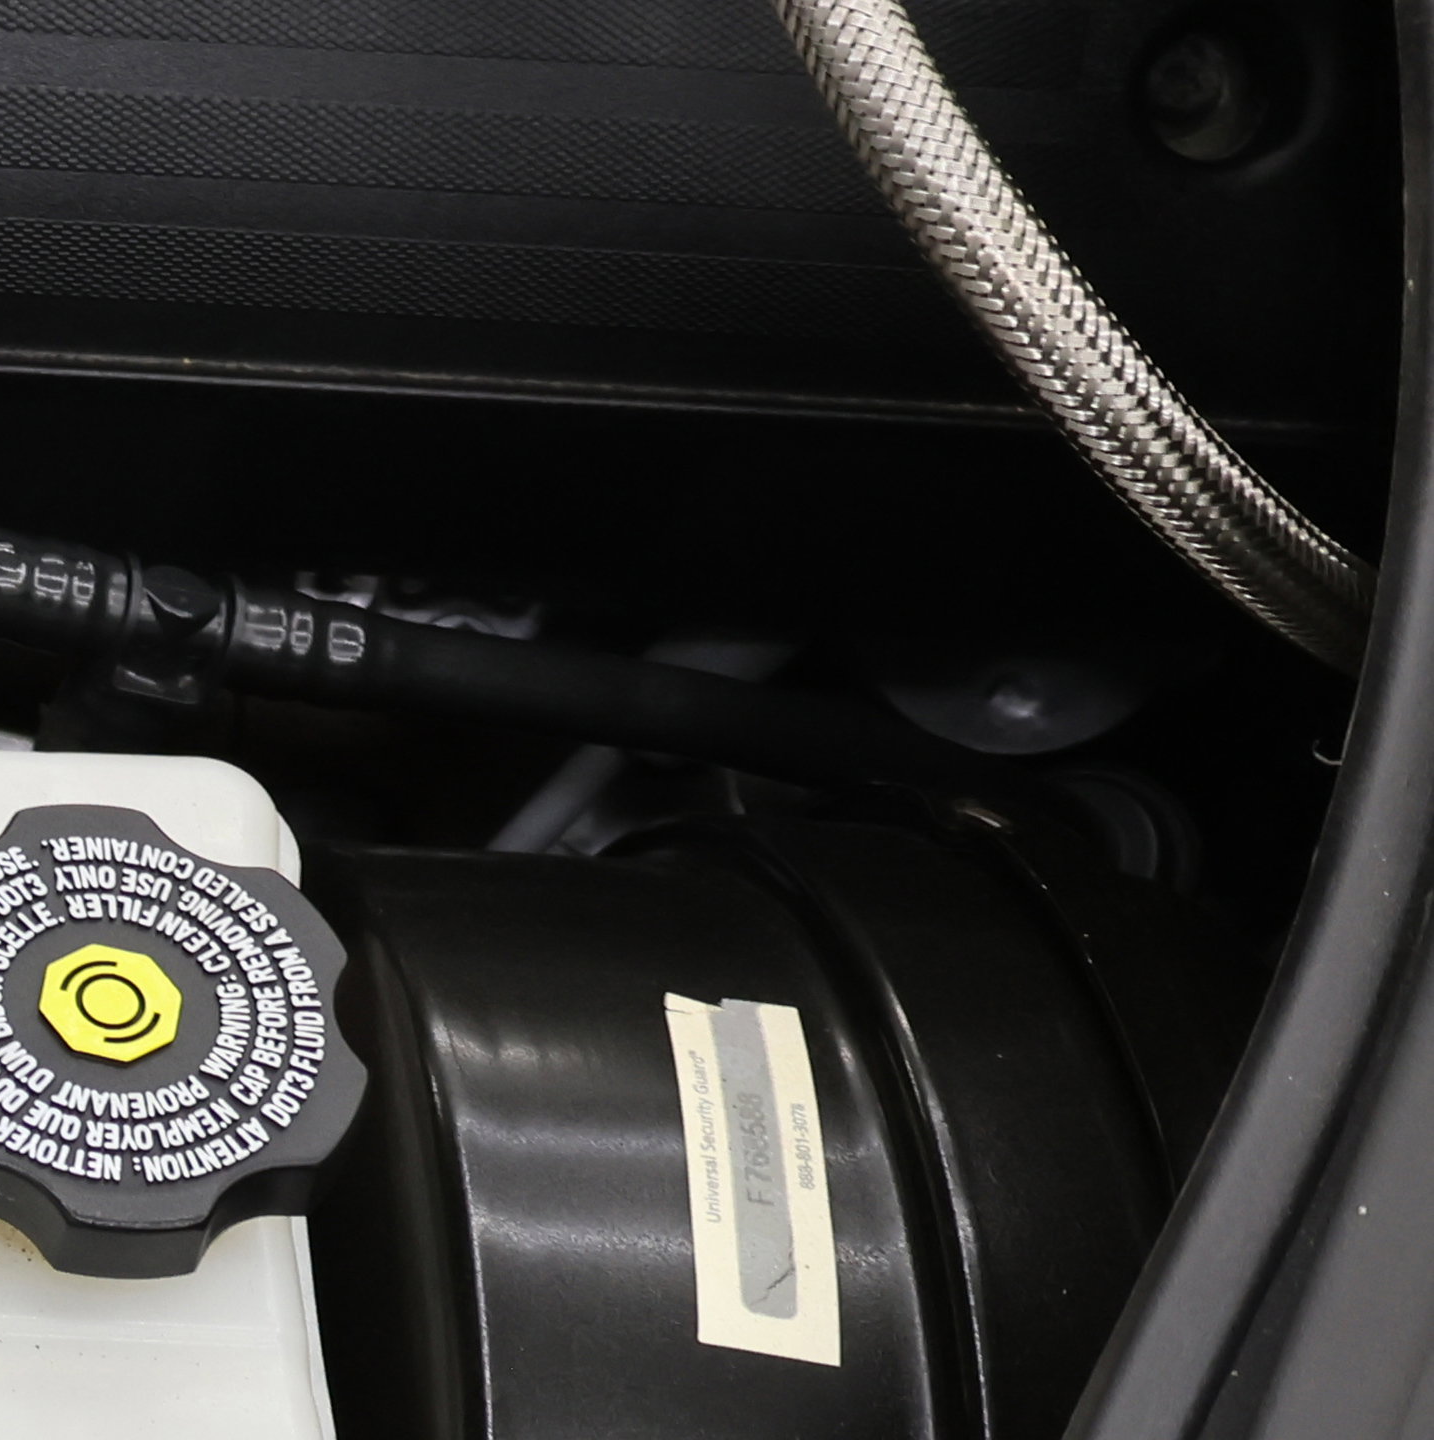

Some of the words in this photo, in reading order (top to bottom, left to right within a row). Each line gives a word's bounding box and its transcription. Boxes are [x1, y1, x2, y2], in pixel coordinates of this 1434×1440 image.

[41, 836, 195, 879] CONTAINER.
[54, 865, 116, 891] ONLY
[65, 893, 159, 928] FILLER
[121, 868, 172, 902] USE
[192, 867, 278, 933] SEALED
[156, 911, 231, 973] CLEAN
[177, 885, 277, 984] REMOVING.
[264, 928, 293, 946] A
[273, 947, 322, 1007] FROM
[199, 974, 251, 1080] WARNING:
[251, 985, 287, 1068] BEFORE
[290, 1011, 325, 1074] FLUID
[50, 1075, 210, 1119] PROVENANT
[230, 1063, 271, 1106] CAP
[261, 1070, 315, 1128] DOT3
[23, 1100, 81, 1141] QUE
[86, 1097, 240, 1151] N'EMPLOYER
[695, 1098, 716, 1152] Security
[133, 1116, 270, 1182] ATTENTION:
[701, 1155, 722, 1223] Universal
[747, 1188, 775, 1206] F
